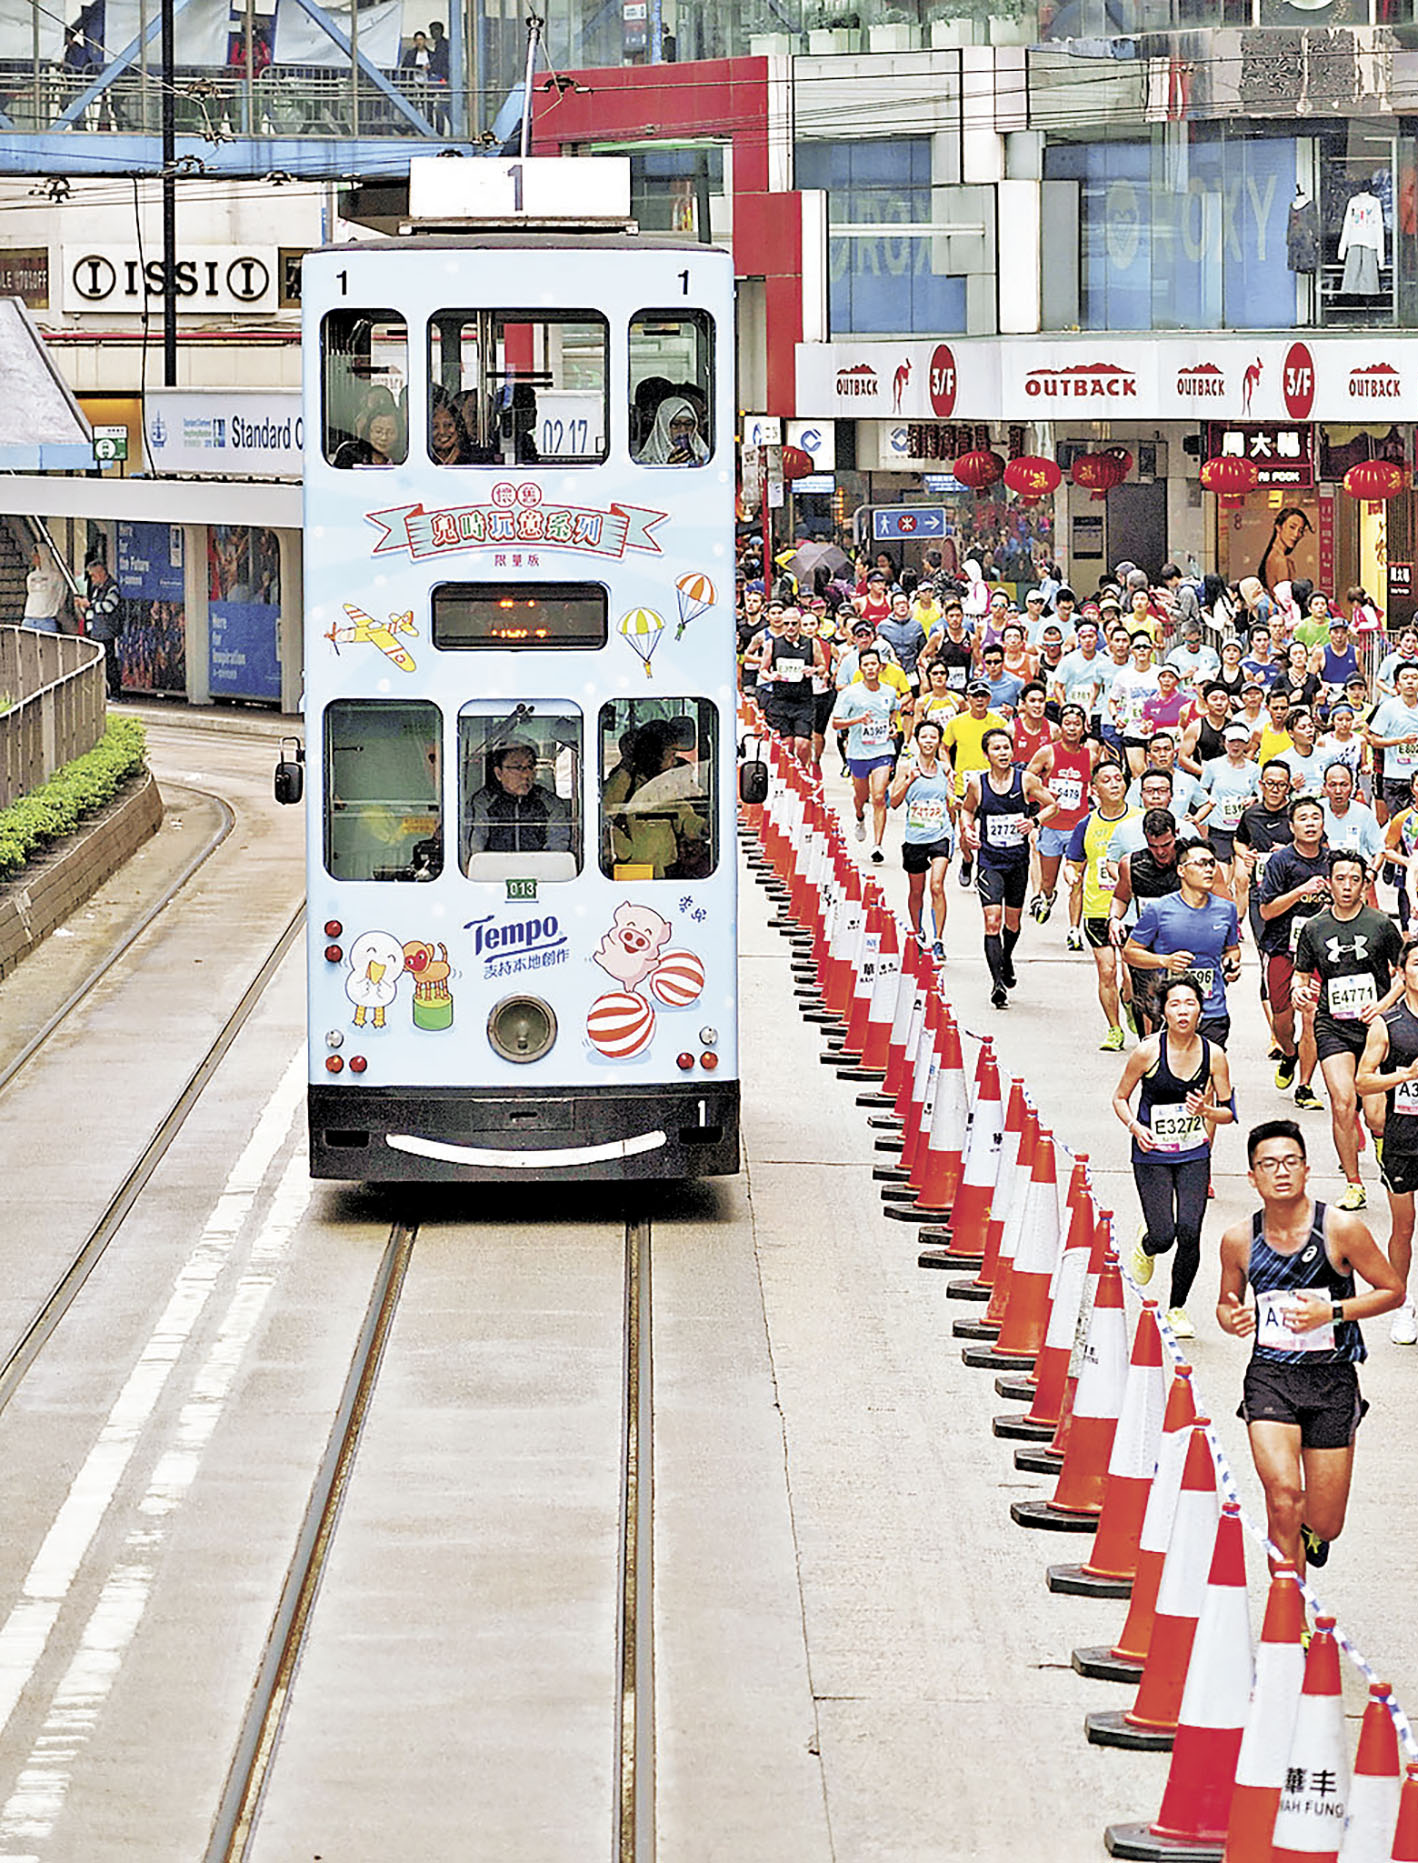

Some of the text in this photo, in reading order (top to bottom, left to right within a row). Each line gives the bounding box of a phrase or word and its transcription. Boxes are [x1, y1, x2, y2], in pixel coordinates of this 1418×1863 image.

[508, 164, 524, 212] 1
[336, 270, 348, 296] 1
[678, 270, 690, 296] 1
[836, 379, 879, 396] OUTBACK
[931, 367, 956, 396] 3/F
[1025, 378, 1137, 397] OUTBACK
[1177, 378, 1225, 396] OUTBACK
[1286, 367, 1313, 397] 3/F
[1348, 378, 1401, 397] OUTBACK
[232, 416, 291, 449] Standard
[1222, 431, 1301, 458] 周大福
[990, 824, 1021, 836] 2772
[509, 881, 536, 897] 013
[463, 914, 565, 958] Tempo
[484, 950, 570, 981] 支持本地創作
[1332, 986, 1374, 1006] E4771
[697, 1100, 707, 1127] 1
[1156, 1114, 1202, 1135] E3272
[1285, 1767, 1338, 1797] 華丰
[1304, 1800, 1345, 1819] FUNG
